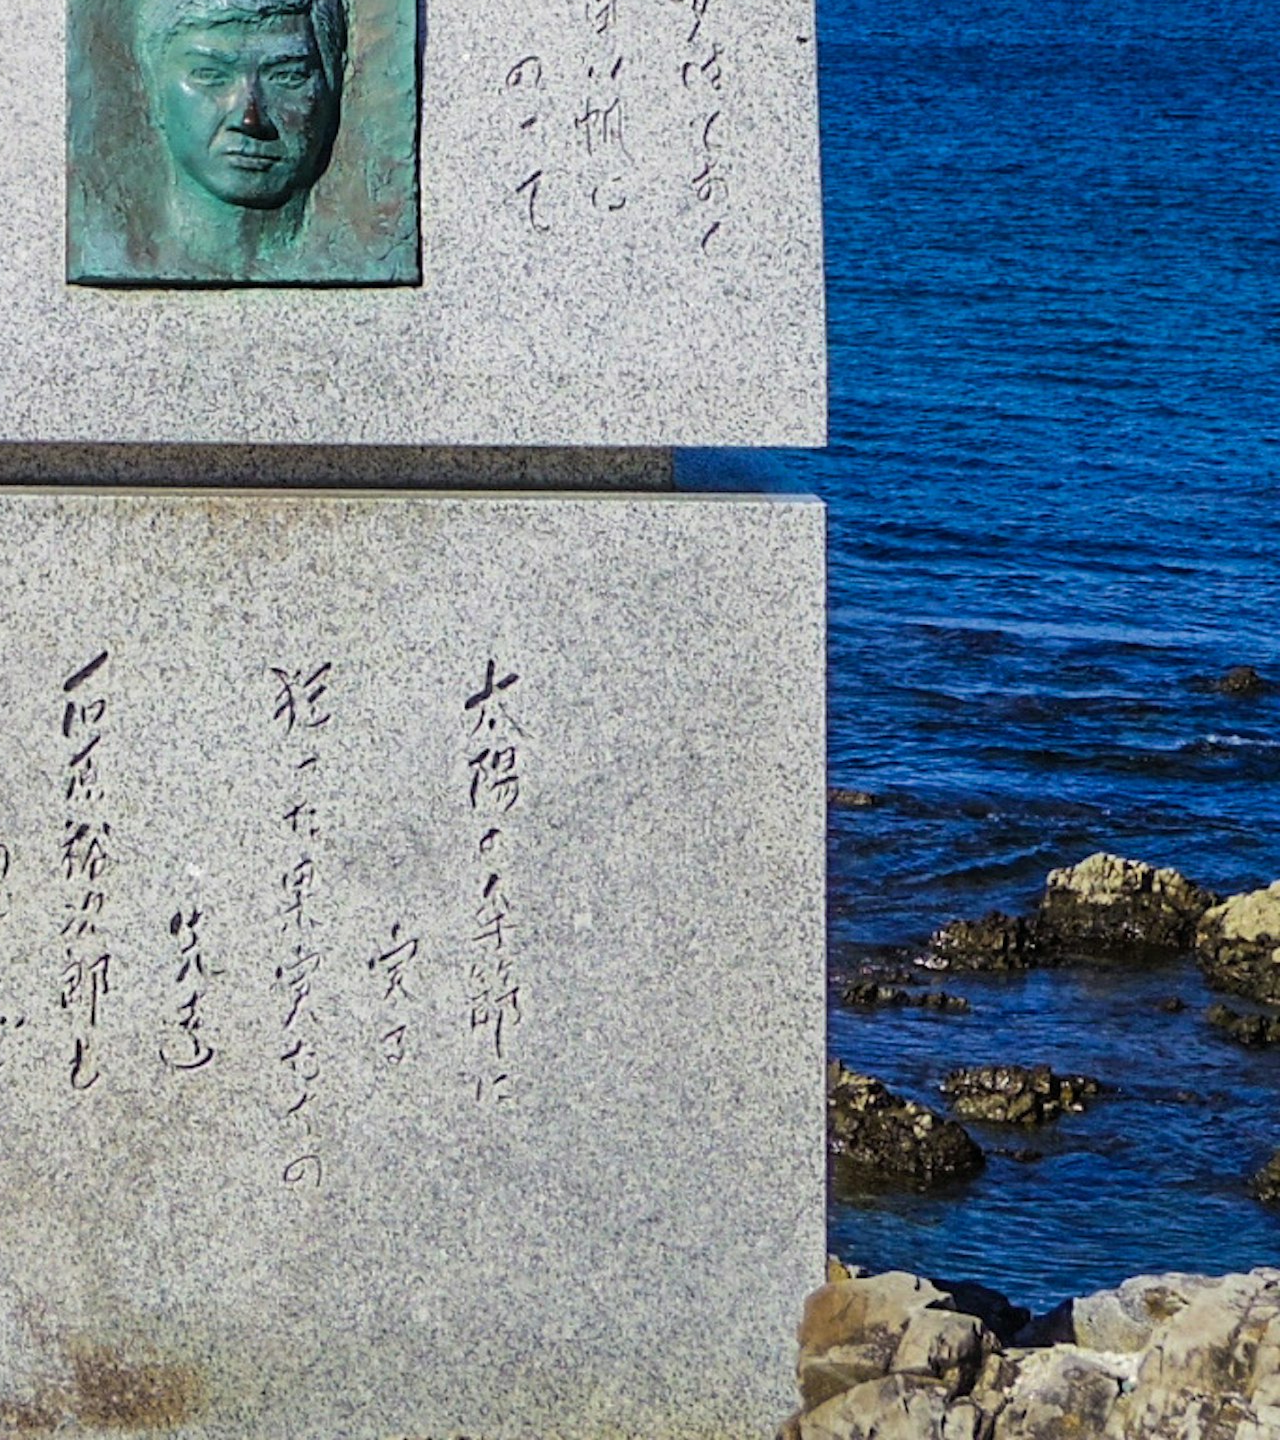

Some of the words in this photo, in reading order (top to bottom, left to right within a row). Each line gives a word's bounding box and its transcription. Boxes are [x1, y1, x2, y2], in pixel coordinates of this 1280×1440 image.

[464, 658, 534, 1103] 太陽の季節に
